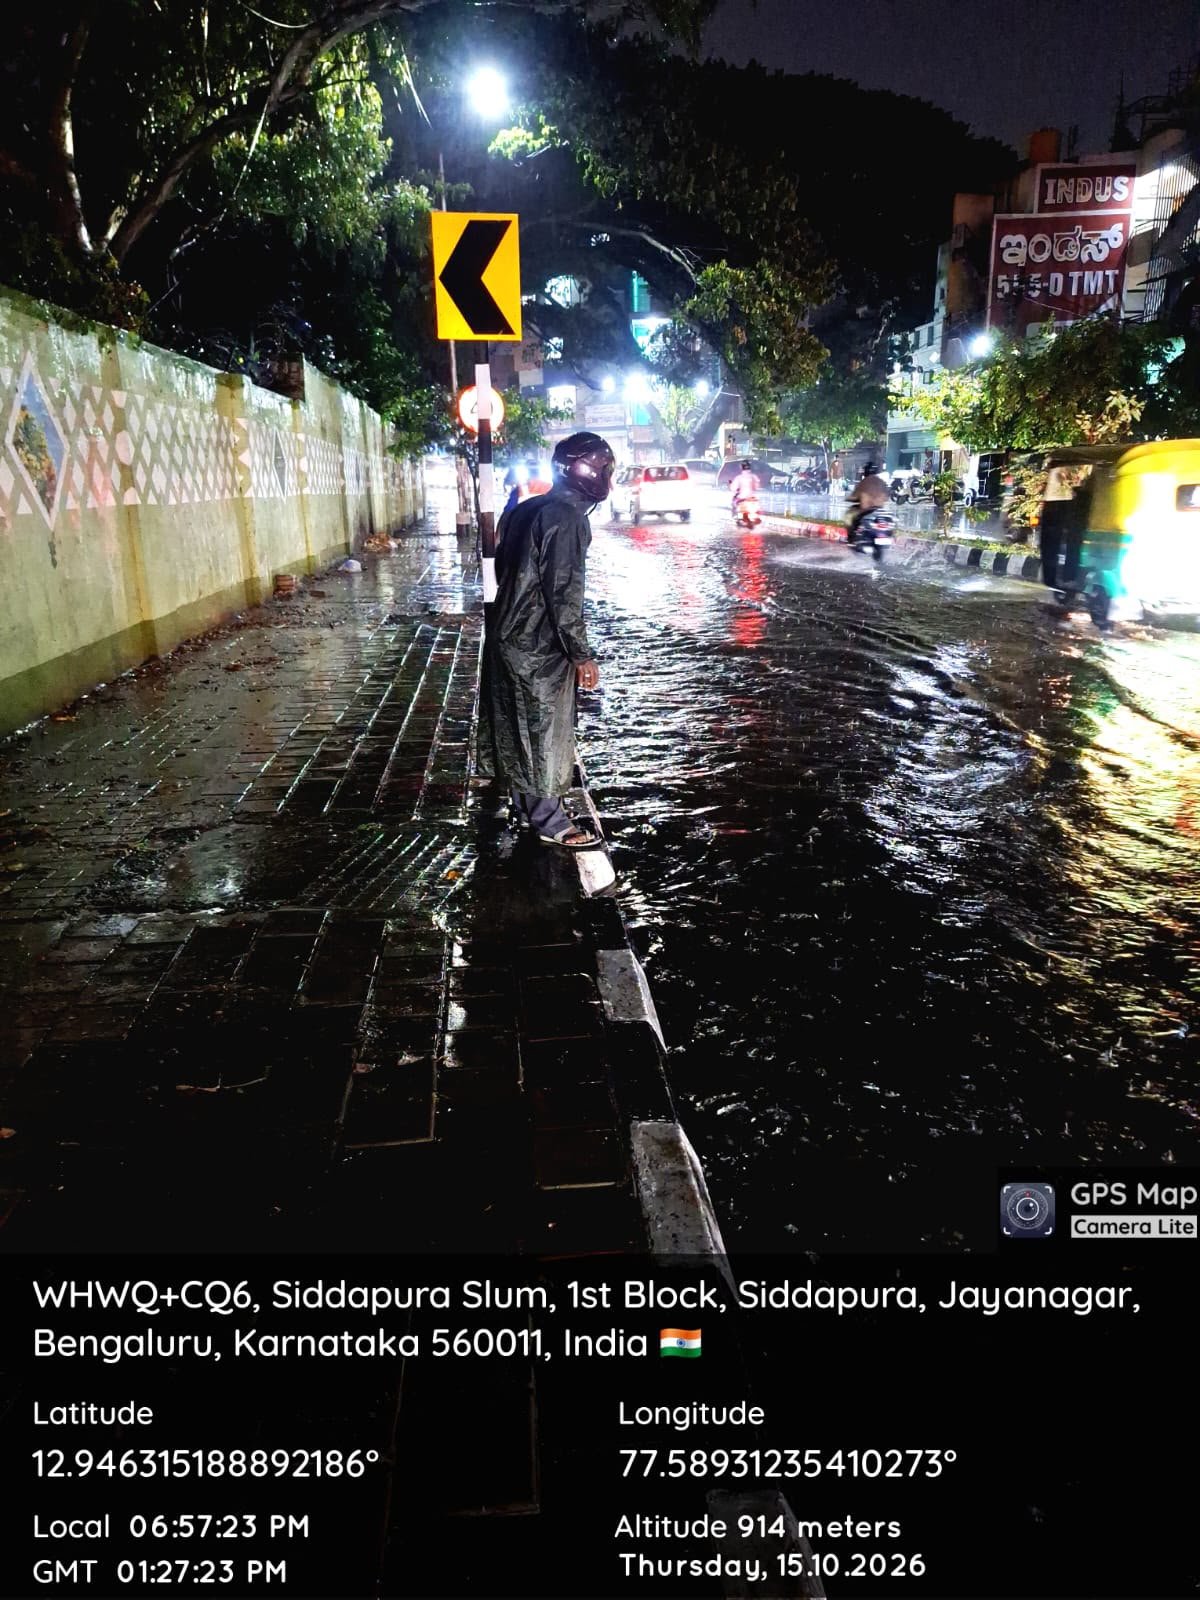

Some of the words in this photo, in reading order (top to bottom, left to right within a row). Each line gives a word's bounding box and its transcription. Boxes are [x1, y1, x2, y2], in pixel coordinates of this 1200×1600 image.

[1043, 176, 1130, 205] INDUS
[999, 222, 1124, 267] ಇಂಡಸ್
[1068, 269, 1120, 296] TMT
